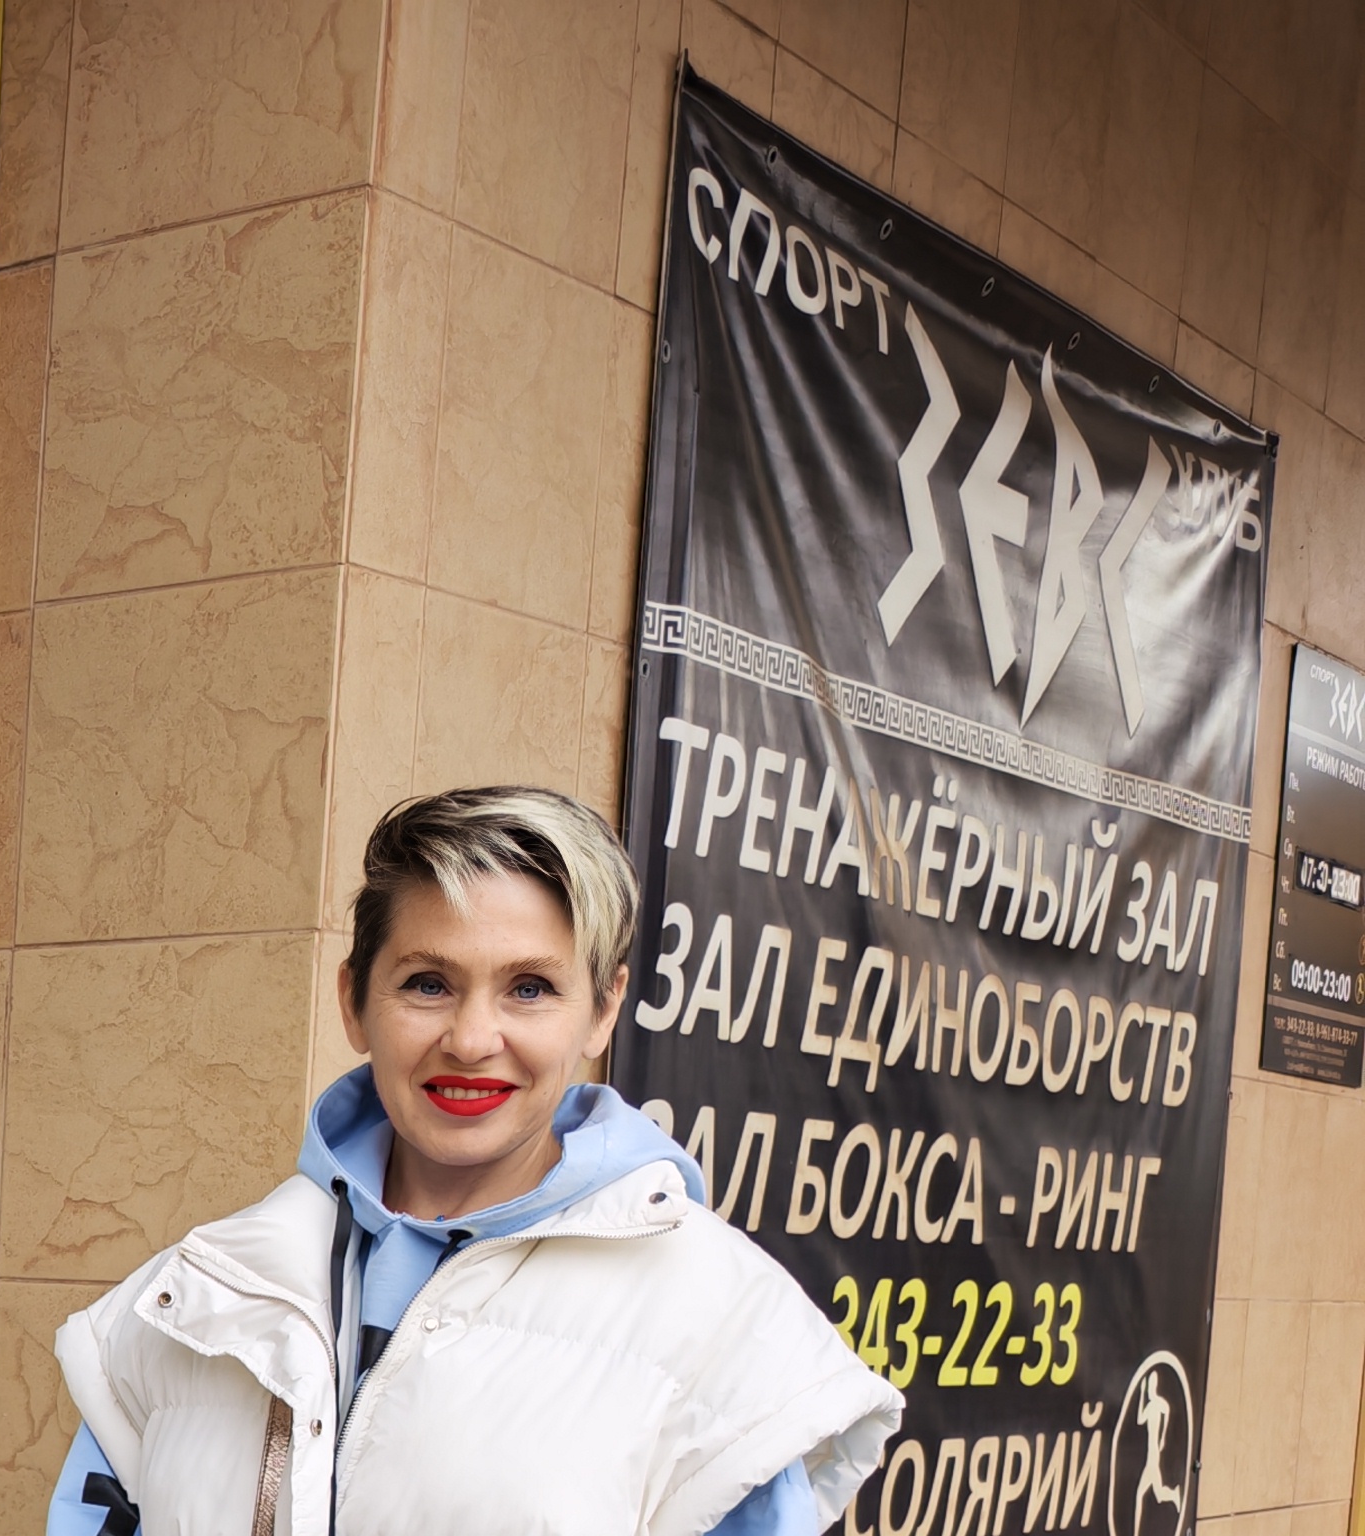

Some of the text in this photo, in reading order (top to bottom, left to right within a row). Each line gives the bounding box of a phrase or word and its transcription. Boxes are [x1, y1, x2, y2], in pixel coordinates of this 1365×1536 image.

[687, 167, 891, 356] СПОРТ
[1310, 663, 1335, 687] СПОРТ
[1306, 746, 1339, 779] РЕЖИМ
[659, 716, 1219, 976] ТРЕНАЖЁРНЫЙ ЗАЛ
[635, 902, 1198, 1107] ЗАЛ ЕДИНОБОРСТВ
[1291, 959, 1351, 1002] 09:00-23:00
[786, 1118, 984, 1244] БОКСА
[1028, 1146, 1162, 1252] РИНГ
